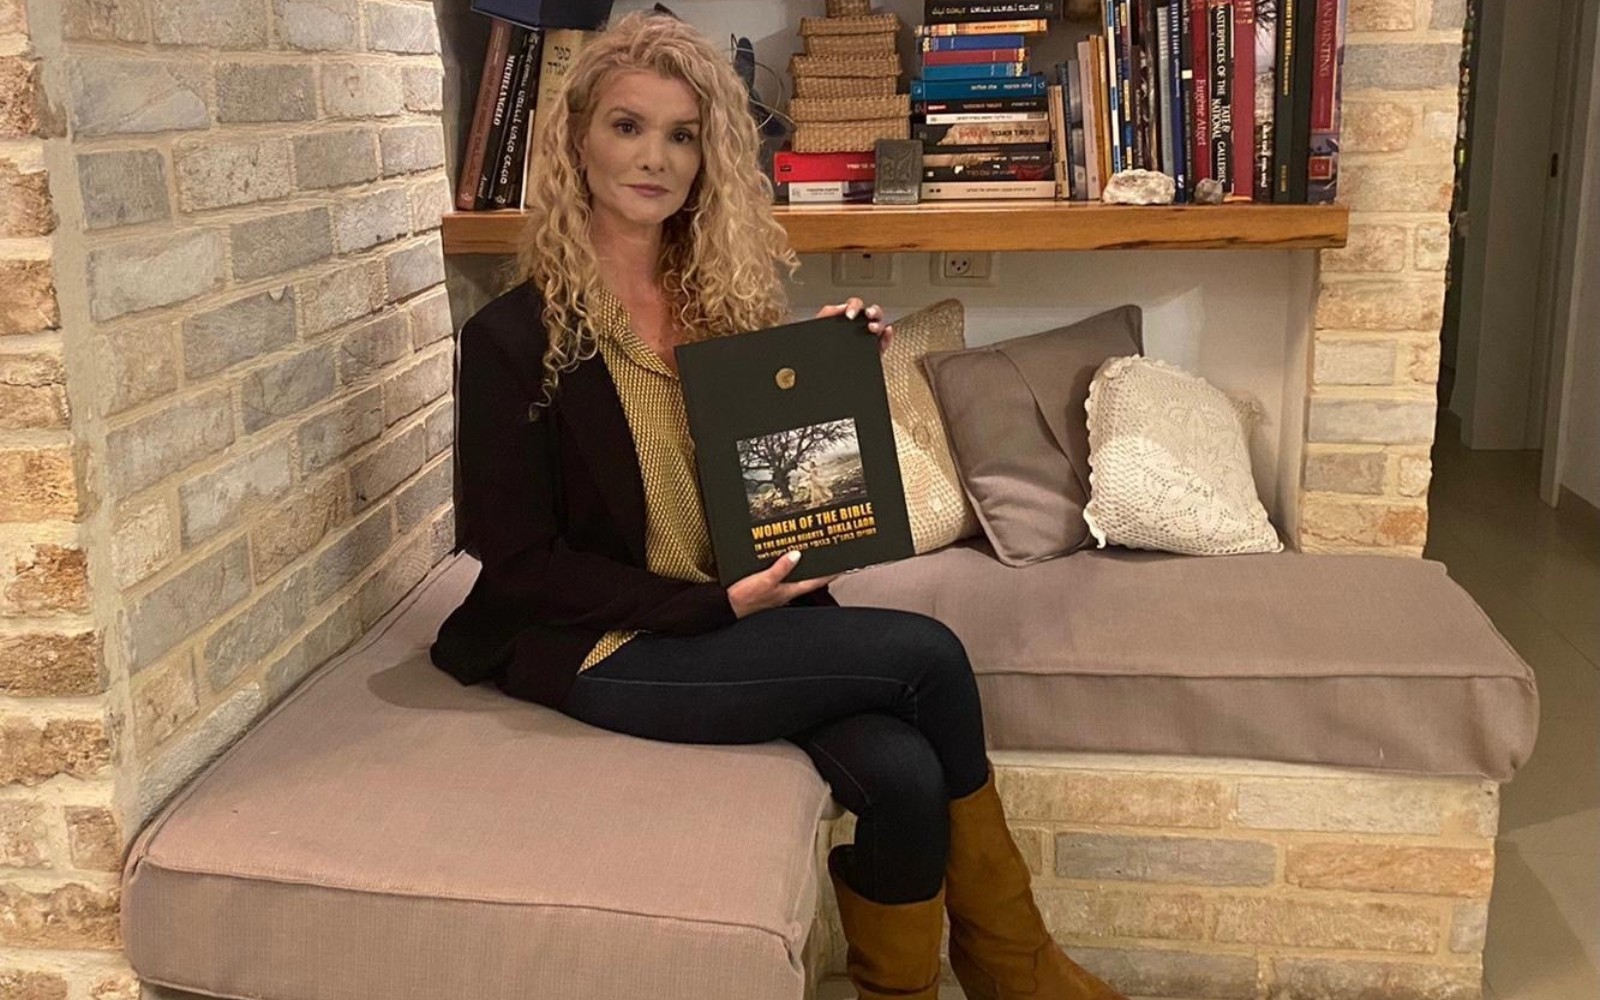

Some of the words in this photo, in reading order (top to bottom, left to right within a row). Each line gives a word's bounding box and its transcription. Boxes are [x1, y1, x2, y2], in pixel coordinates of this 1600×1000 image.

[1320, 18, 1332, 77] PAINTING
[1216, 65, 1226, 77] OF
[493, 53, 516, 126] MICHELANGELO
[1216, 80, 1226, 96] THE
[511, 89, 528, 124] המדריך
[1211, 98, 1222, 140] NATIONAL
[1221, 104, 1231, 124] TATE
[506, 125, 519, 153] השלם
[1195, 118, 1207, 146] Atget
[498, 155, 512, 185] לצילום
[1217, 141, 1227, 184] GALLERIES
[751, 519, 796, 539] WOMEN
[799, 515, 814, 528] OF
[816, 510, 838, 525] THE
[839, 502, 872, 520] BIBLE
[763, 540, 775, 548] THE
[776, 535, 796, 545] GOLAN
[827, 521, 852, 534] DIKLA
[853, 516, 874, 528] LAOR
